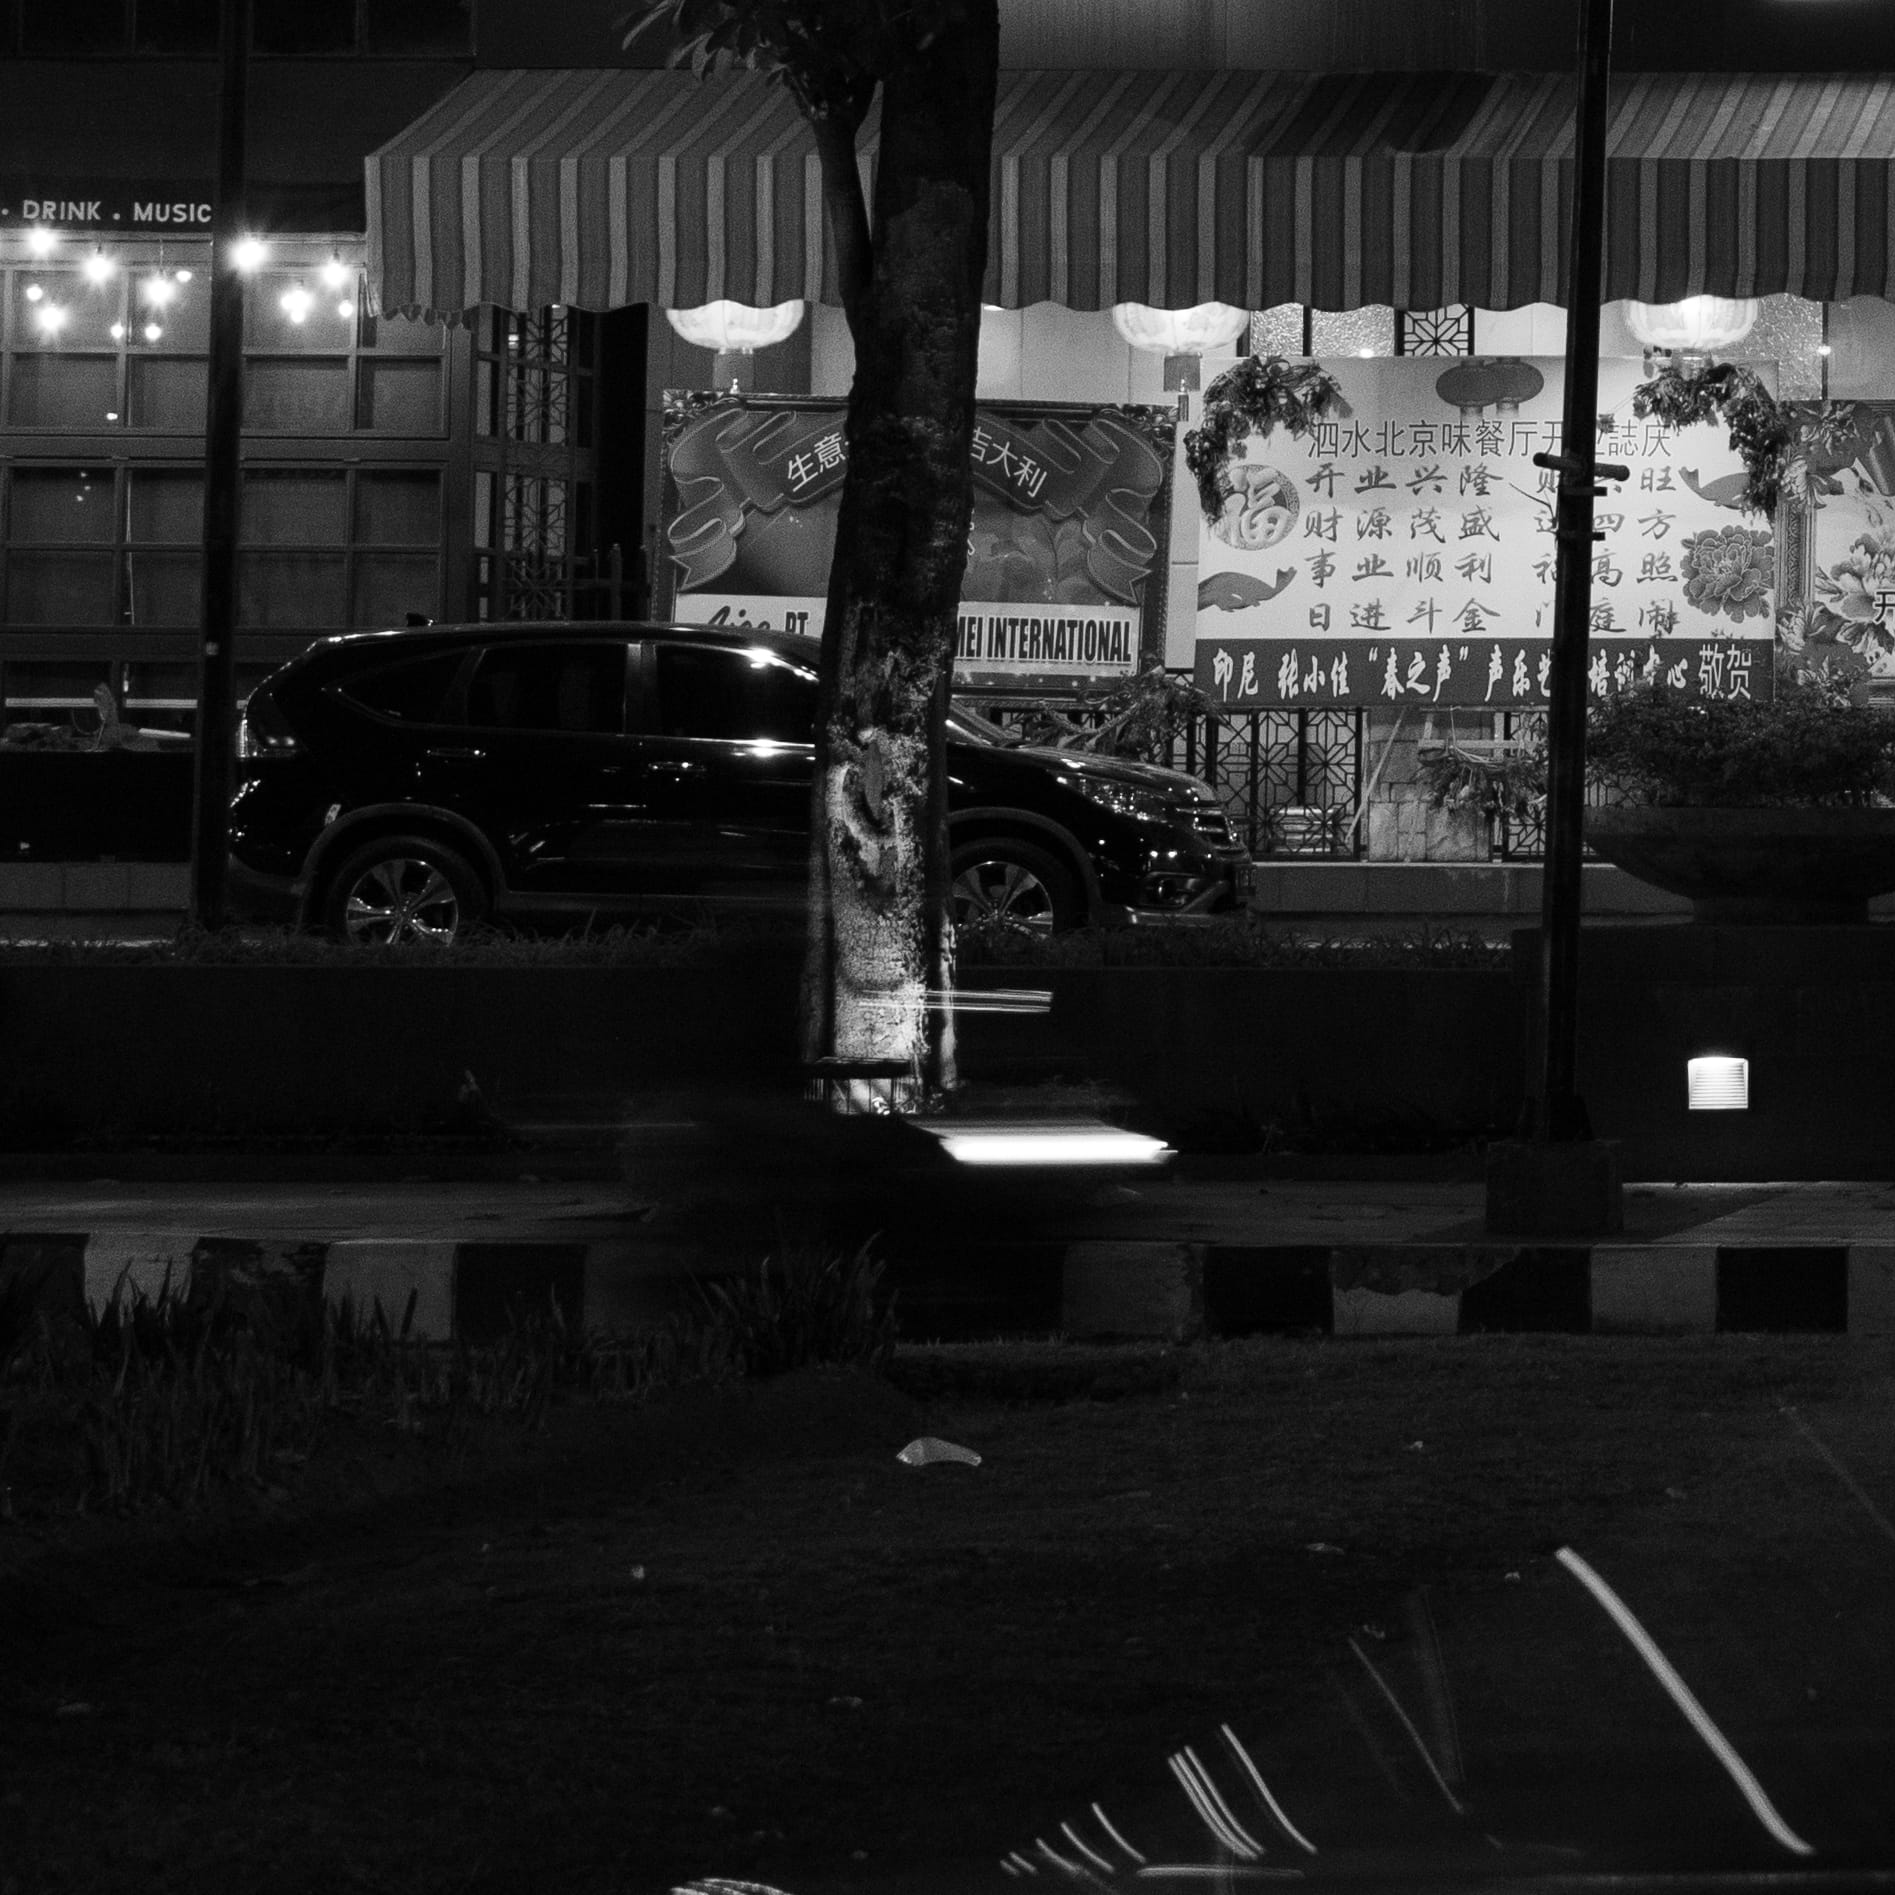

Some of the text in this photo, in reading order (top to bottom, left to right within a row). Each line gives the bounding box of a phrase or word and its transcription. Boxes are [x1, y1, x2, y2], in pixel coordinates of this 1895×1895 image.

[22, 199, 213, 223] DRINK MUSIC
[787, 432, 850, 492] 生意
[1305, 462, 1503, 498] 开业兴隆
[1309, 597, 1501, 635] 日进斗金
[988, 617, 1131, 662] INTERNATIONAL
[1484, 643, 1688, 702] 声乐艺培训中心
[1699, 643, 1751, 701] 敬贺
